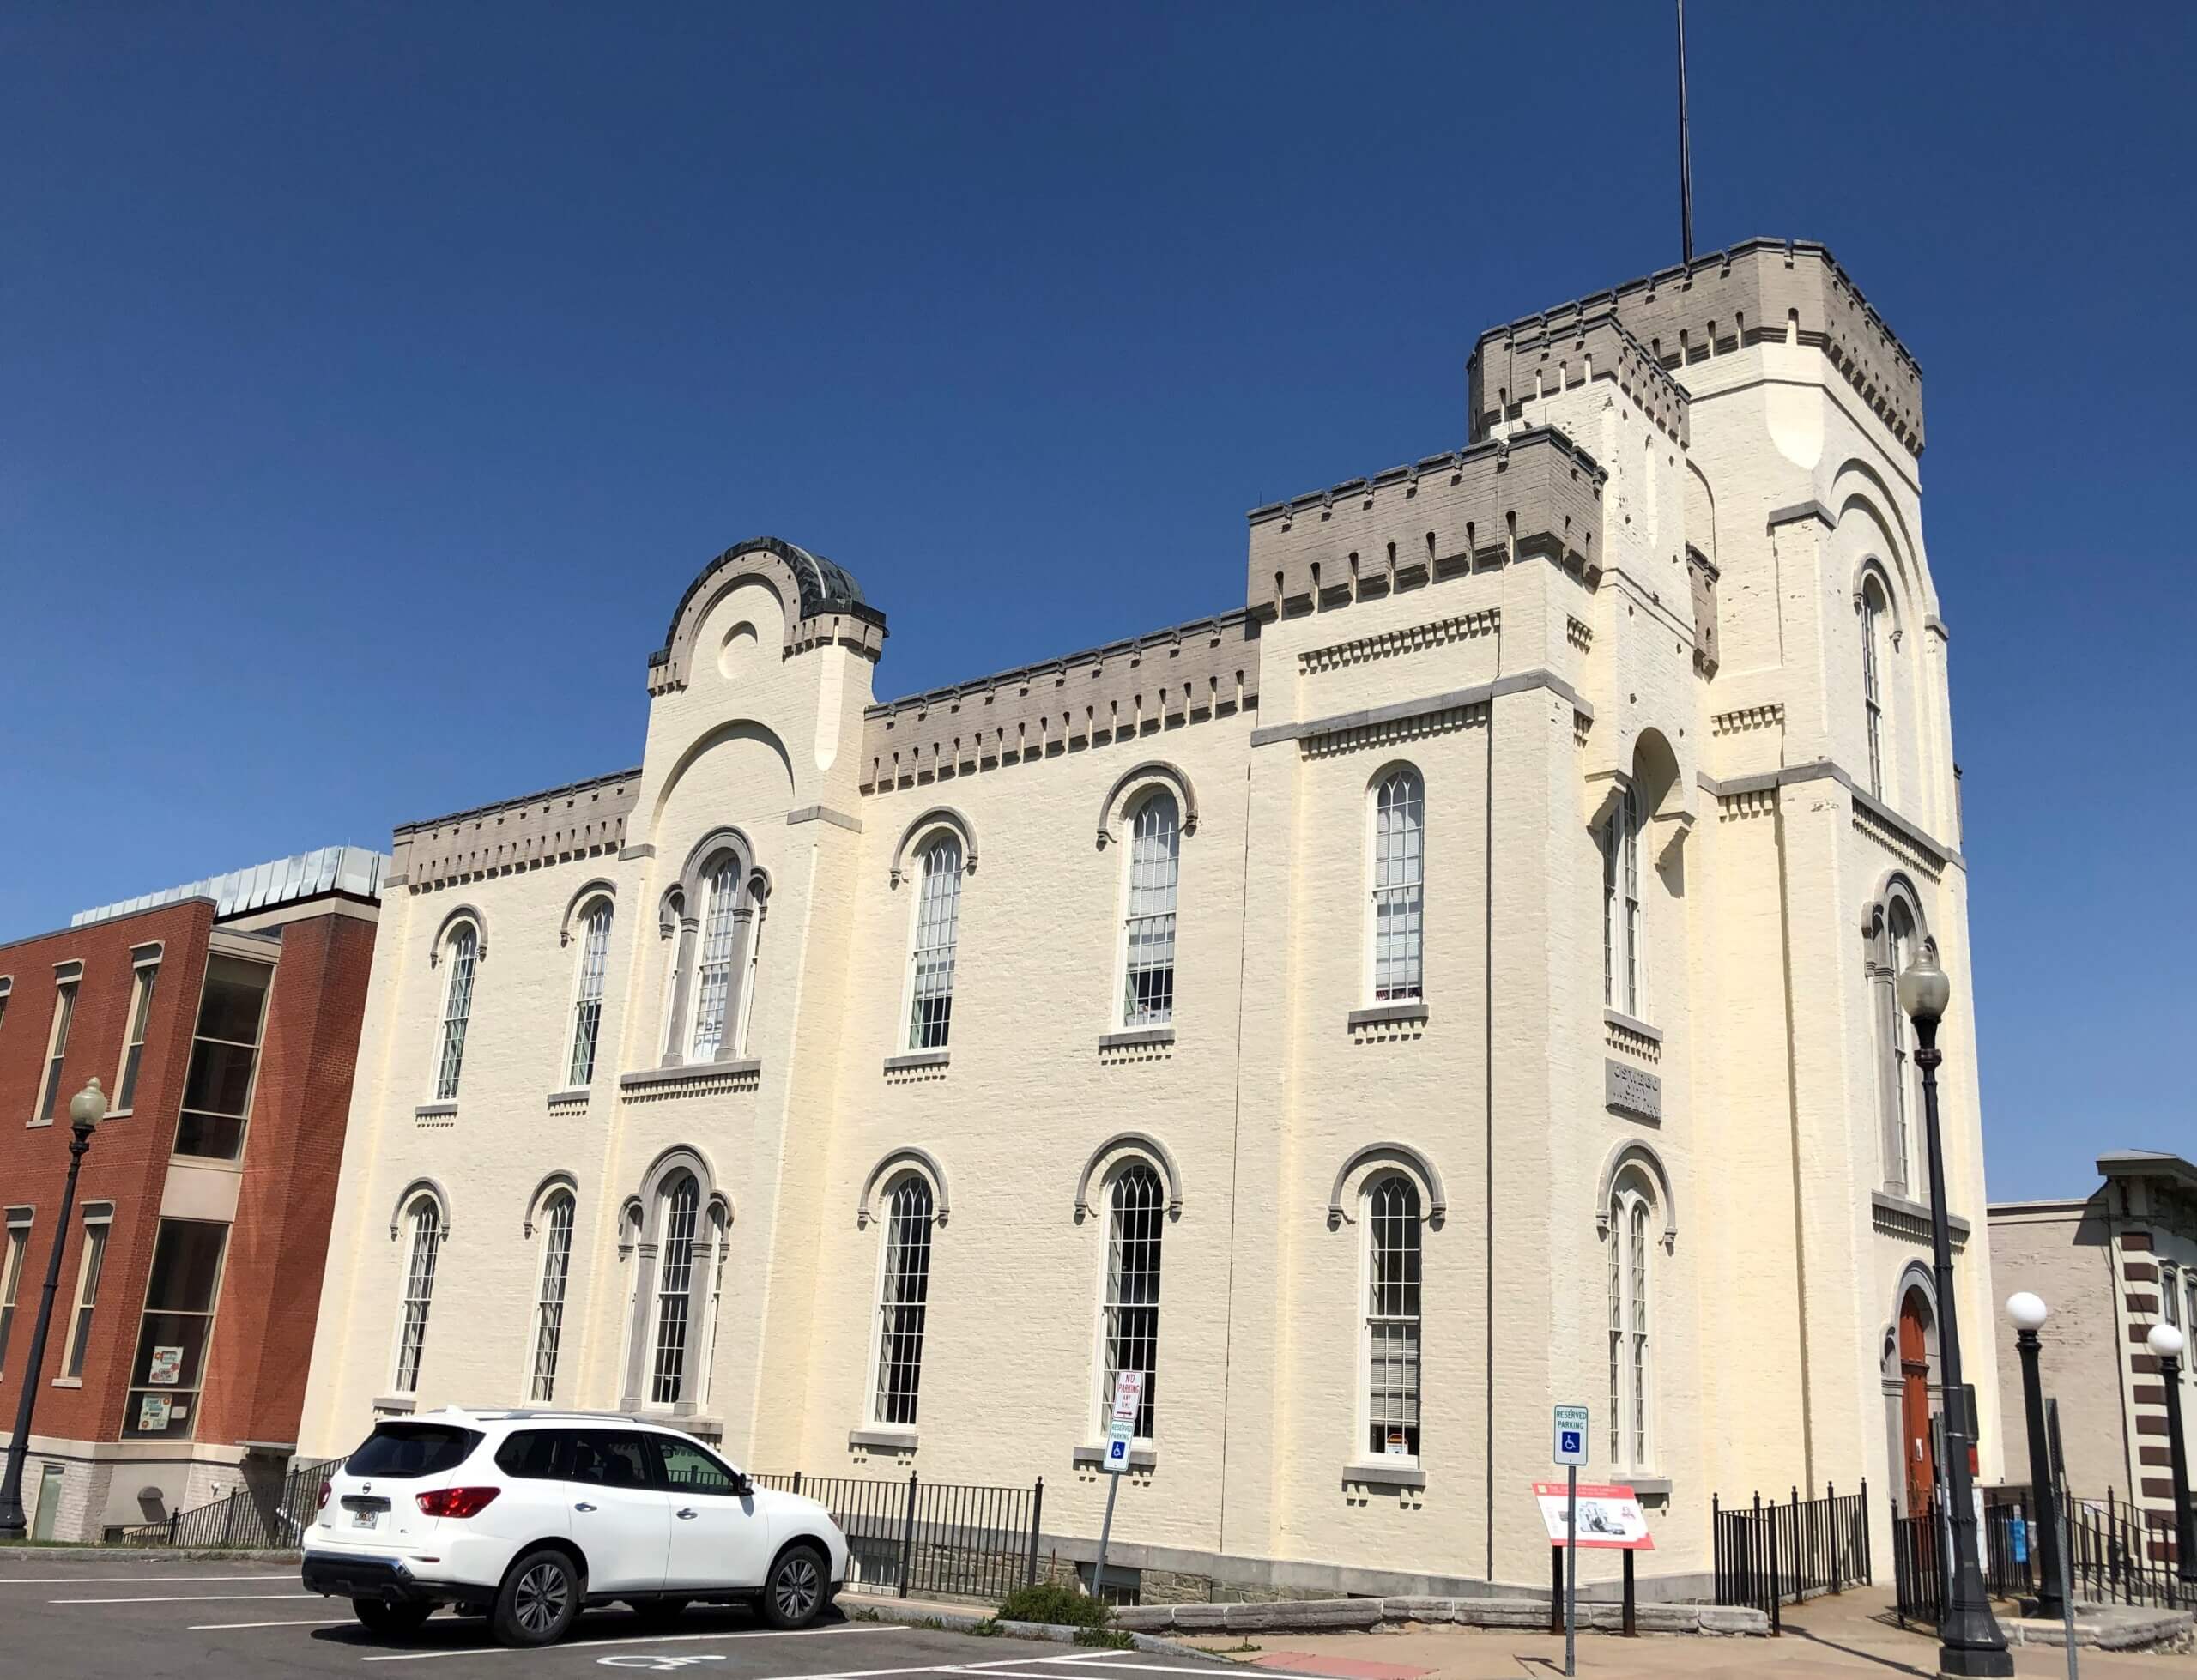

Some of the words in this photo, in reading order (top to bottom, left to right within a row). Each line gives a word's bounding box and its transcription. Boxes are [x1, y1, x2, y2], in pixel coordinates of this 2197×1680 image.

[1126, 1374, 1135, 1383] NO
[1118, 1383, 1140, 1394] PARKING
[1556, 1411, 1587, 1420] RESERVED
[1557, 1420, 1584, 1429] PARKING
